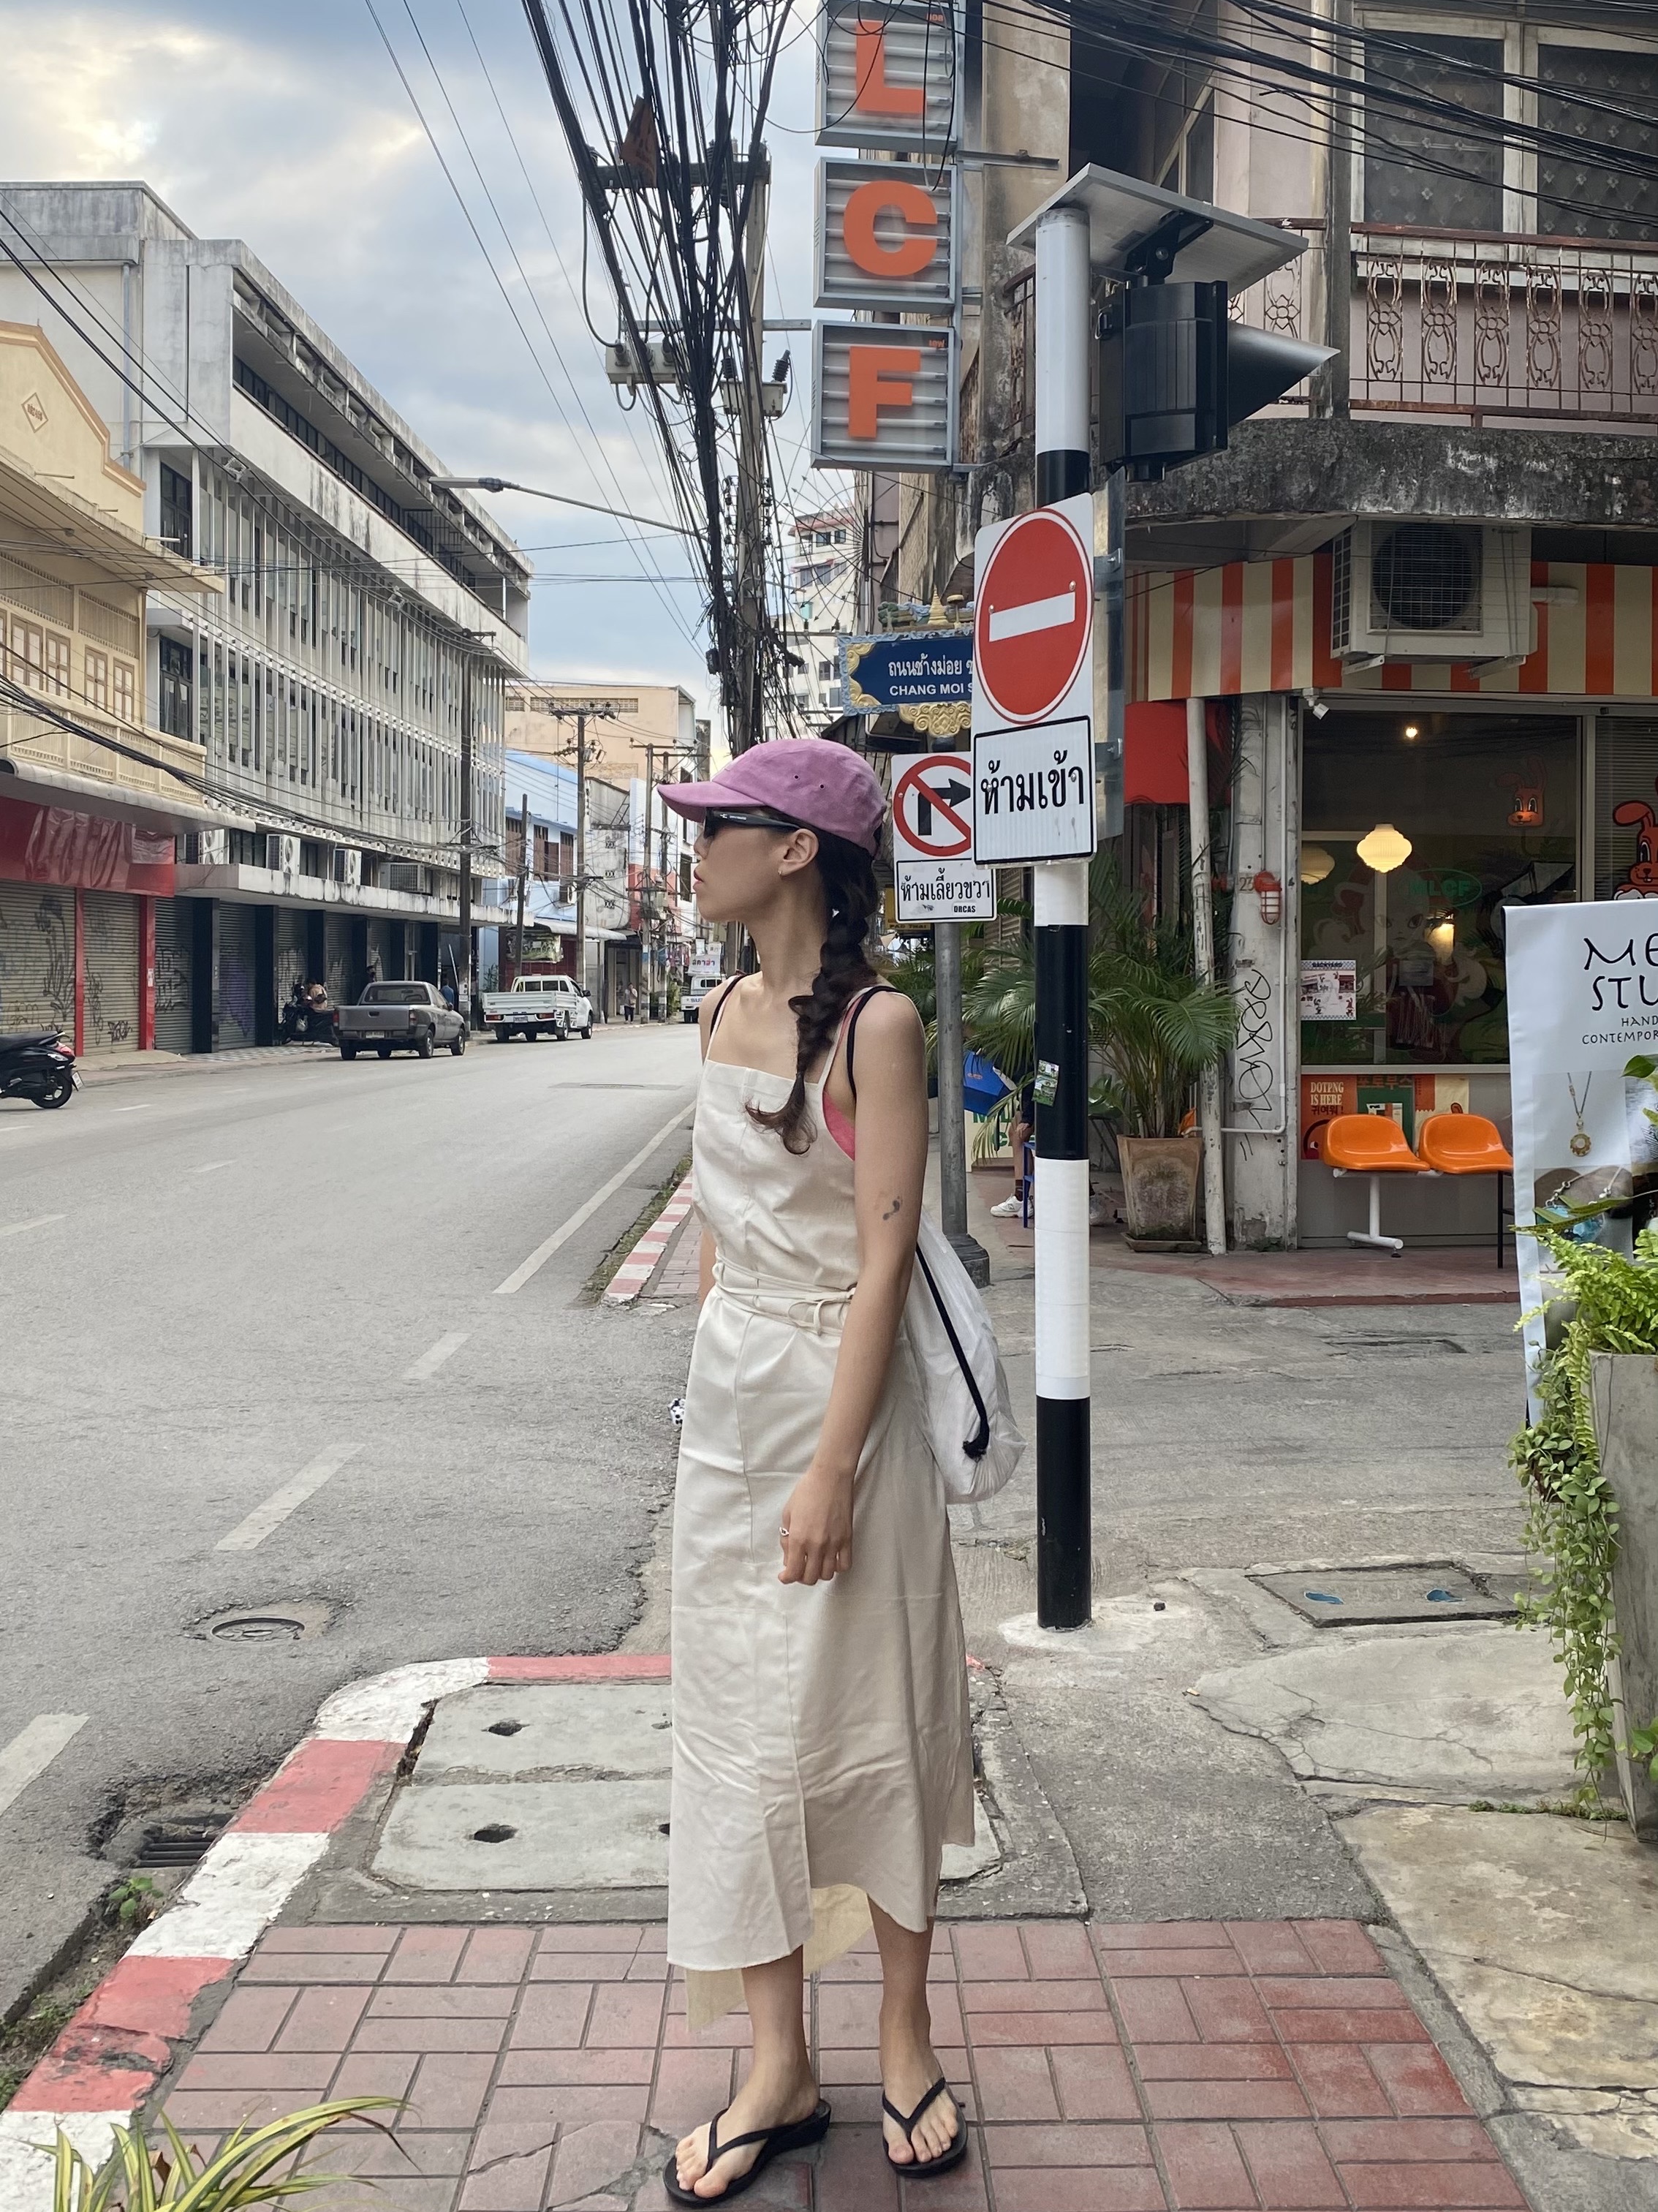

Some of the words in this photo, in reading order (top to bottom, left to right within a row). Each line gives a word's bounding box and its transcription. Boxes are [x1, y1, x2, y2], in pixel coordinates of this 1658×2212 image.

[888, 653, 963, 676] ถนนช้างม่อย
[890, 684, 936, 695] CHANG
[940, 683, 964, 694] MOI
[980, 750, 1084, 815] ห้ามเข้า
[901, 867, 990, 901] ห้ามเลี้ยวขวา
[1583, 933, 1658, 971] ME
[1591, 975, 1658, 1011] STU
[1310, 1082, 1344, 1093] DOTPNG
[1310, 1094, 1319, 1106] IS
[1320, 1094, 1342, 1106] HERE
